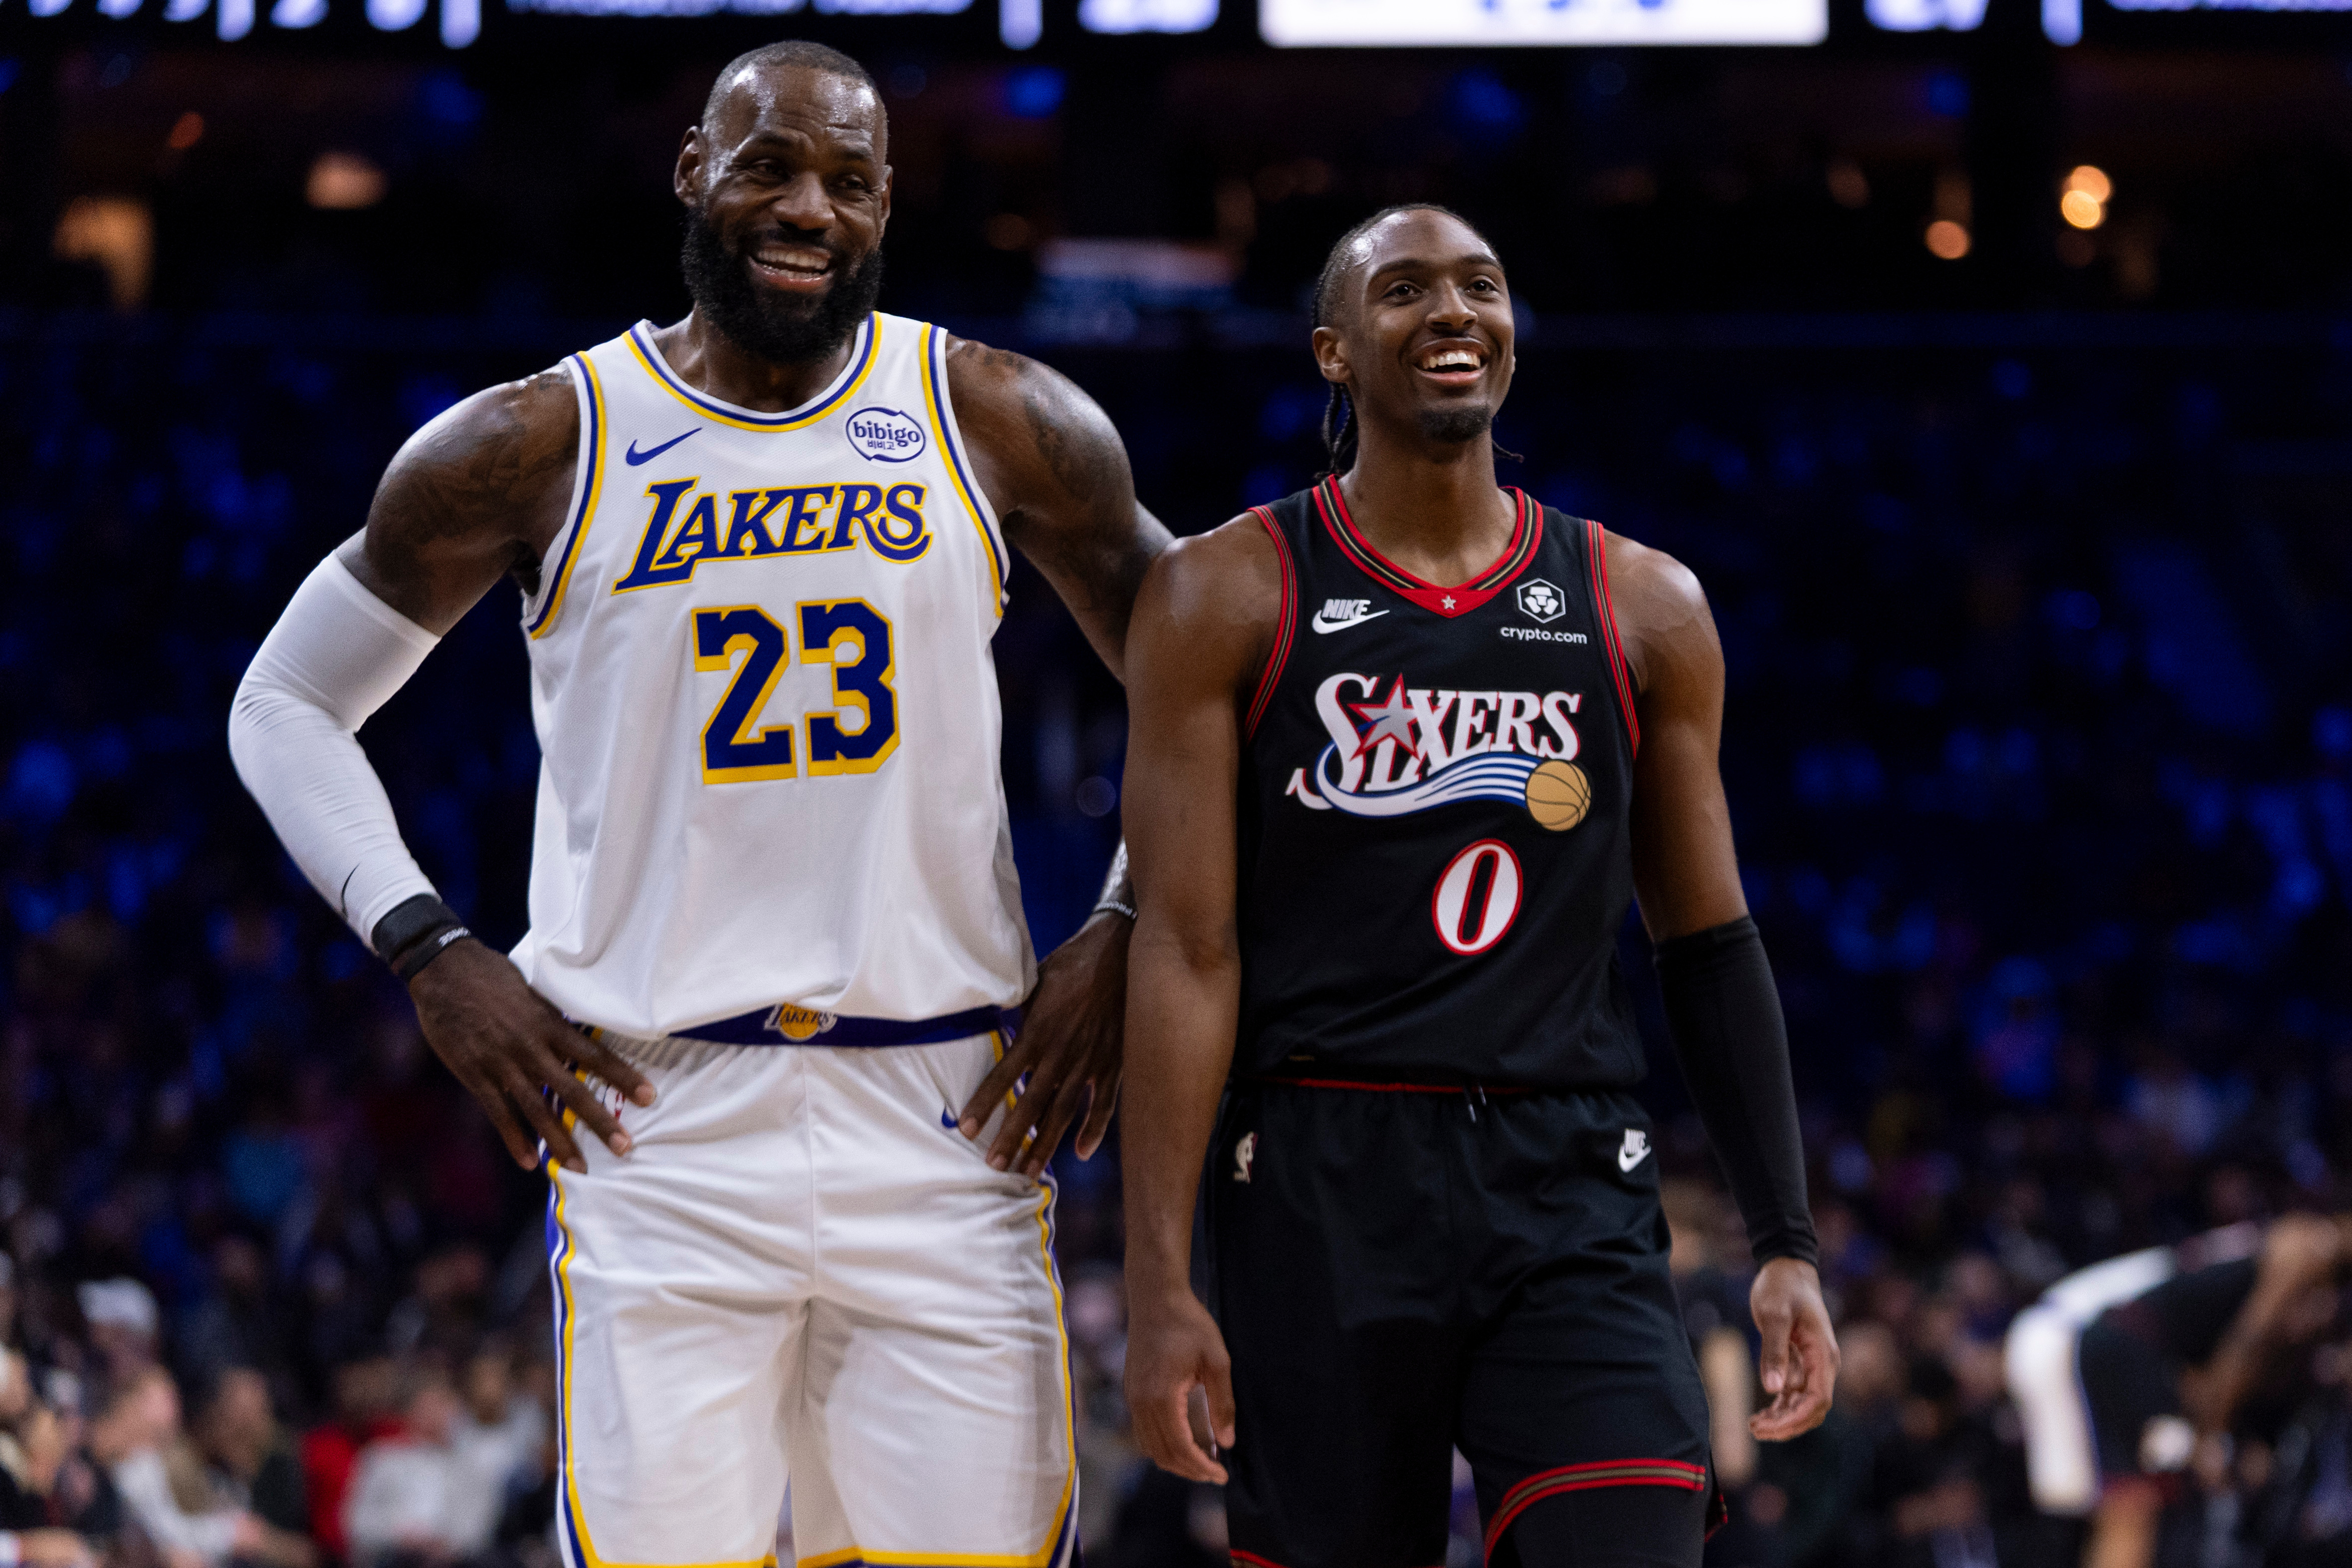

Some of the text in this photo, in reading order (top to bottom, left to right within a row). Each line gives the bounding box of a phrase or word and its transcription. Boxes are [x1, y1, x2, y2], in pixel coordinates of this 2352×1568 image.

[854, 420, 921, 447] bibigo
[867, 439, 896, 450] 비비고
[612, 476, 933, 595] LAKERS
[1322, 598, 1371, 620] NIKE
[1500, 626, 1587, 644] crypto.com
[691, 597, 900, 784] 23
[1285, 673, 1583, 810] SIXERS
[1431, 838, 1523, 956] 0
